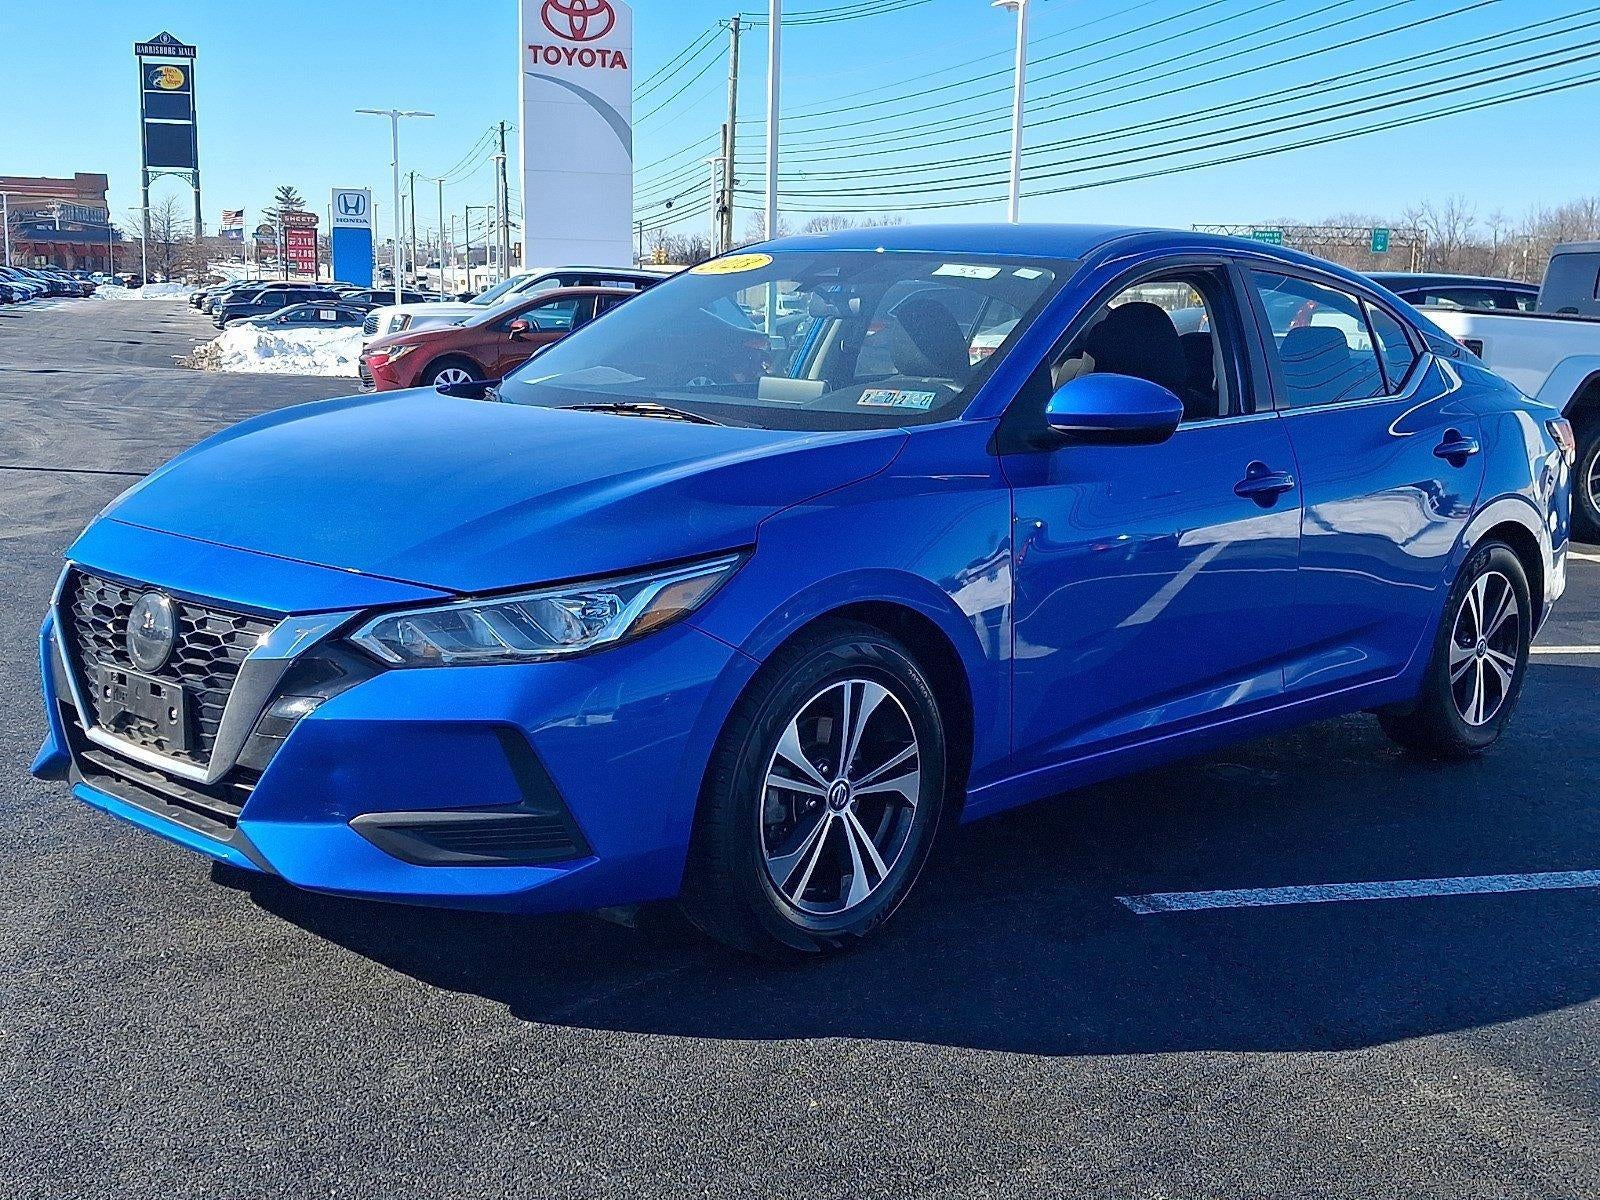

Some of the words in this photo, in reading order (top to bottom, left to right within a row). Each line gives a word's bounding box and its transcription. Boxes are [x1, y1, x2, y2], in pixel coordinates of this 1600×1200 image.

[136, 45, 176, 55] HARRISBURG
[178, 47, 195, 57] MALL
[528, 45, 628, 70] TOYOTA
